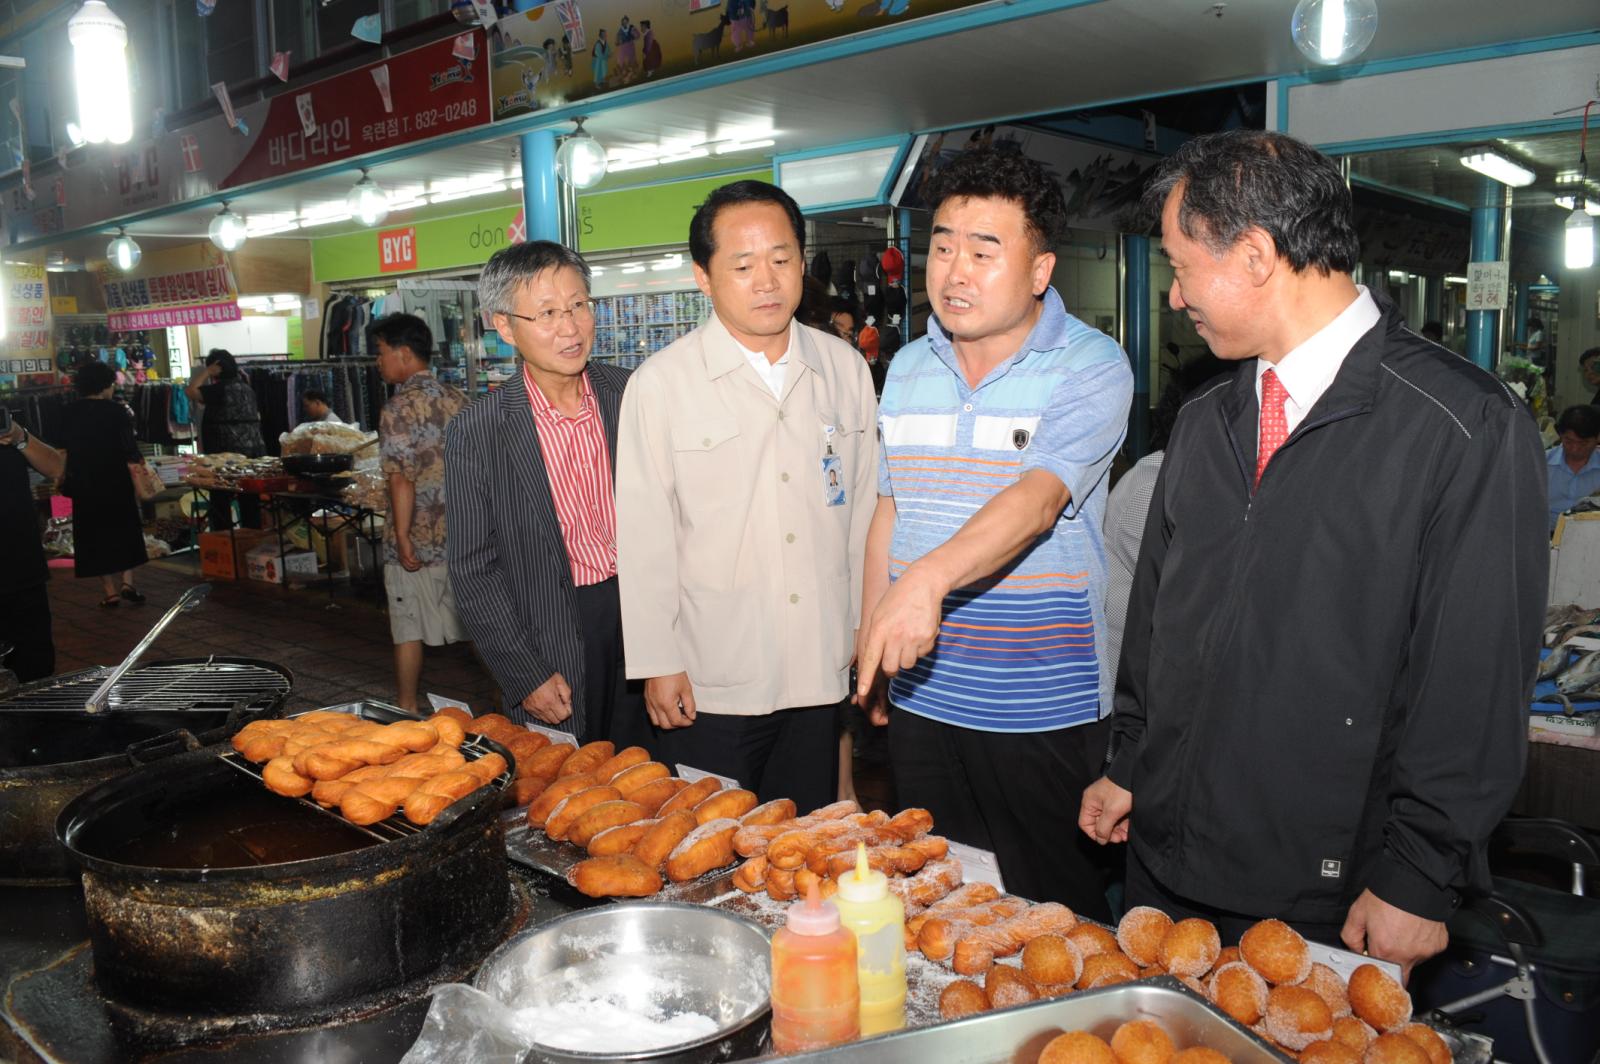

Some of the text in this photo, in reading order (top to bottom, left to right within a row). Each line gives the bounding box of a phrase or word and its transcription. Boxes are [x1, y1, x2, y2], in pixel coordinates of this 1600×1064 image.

[268, 117, 350, 166] 바디라인
[361, 98, 477, 143] 옥련점 T. 832-0248
[118, 146, 160, 196] BC
